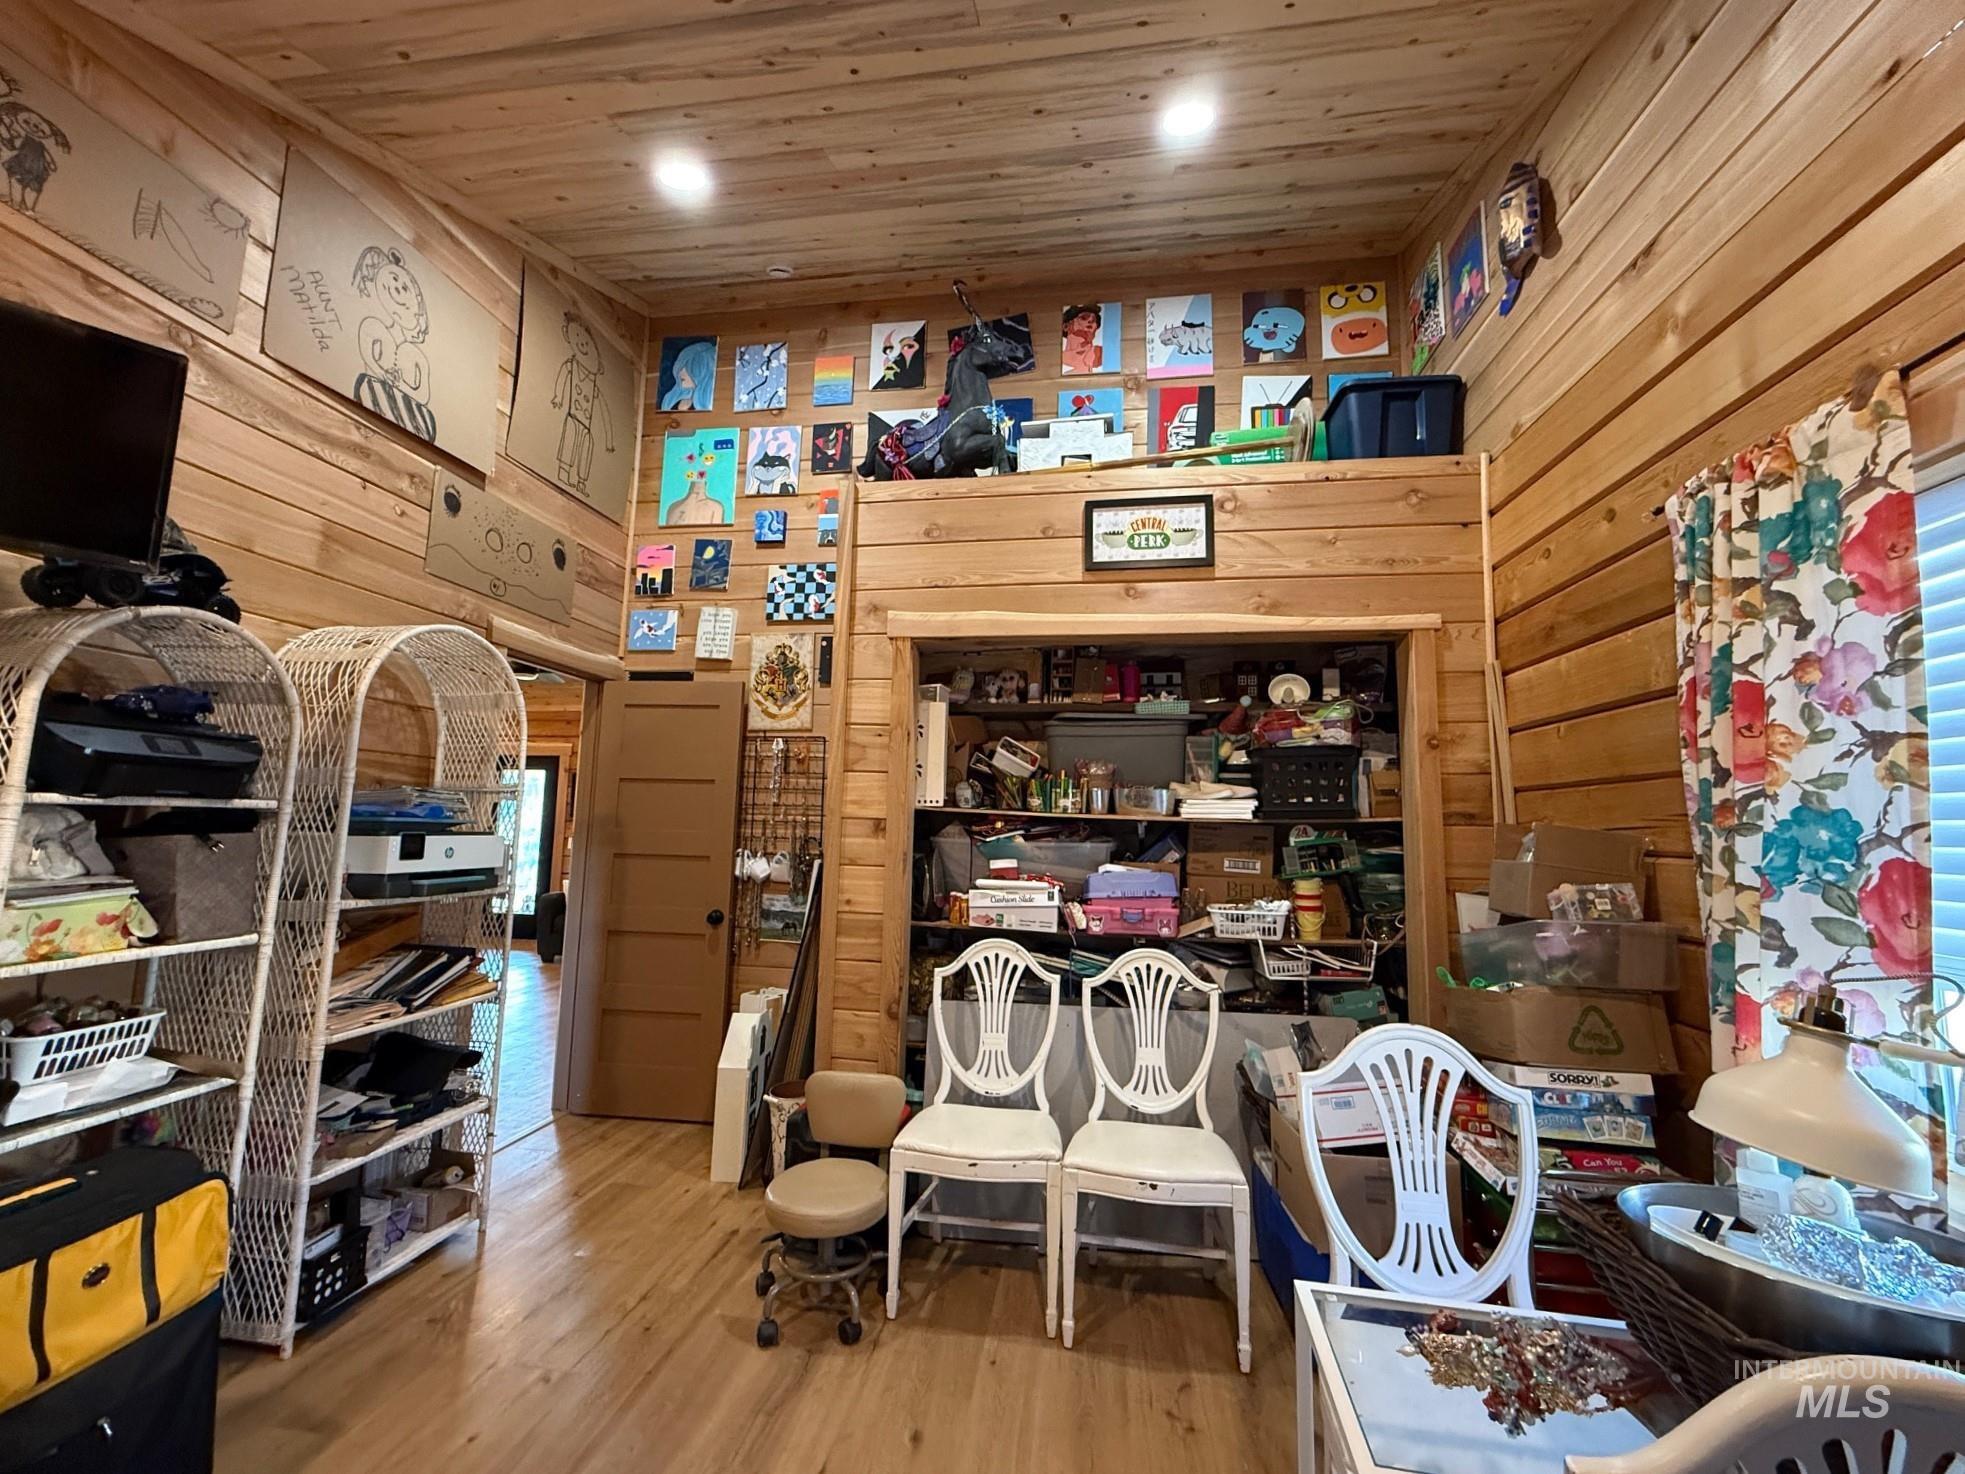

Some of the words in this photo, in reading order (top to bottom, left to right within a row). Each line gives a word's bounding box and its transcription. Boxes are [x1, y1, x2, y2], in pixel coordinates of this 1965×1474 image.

[306, 270, 343, 331] AUNT
[1130, 516, 1166, 532] CENTRAL
[1133, 534, 1165, 548] PERK
[1294, 827, 1308, 837] 24
[990, 895, 1017, 904] Cushion
[1018, 894, 1036, 903] Slide
[1549, 1072, 1599, 1087] SORRY!
[1583, 1158, 1602, 1167] Can
[1603, 1157, 1622, 1167] You
